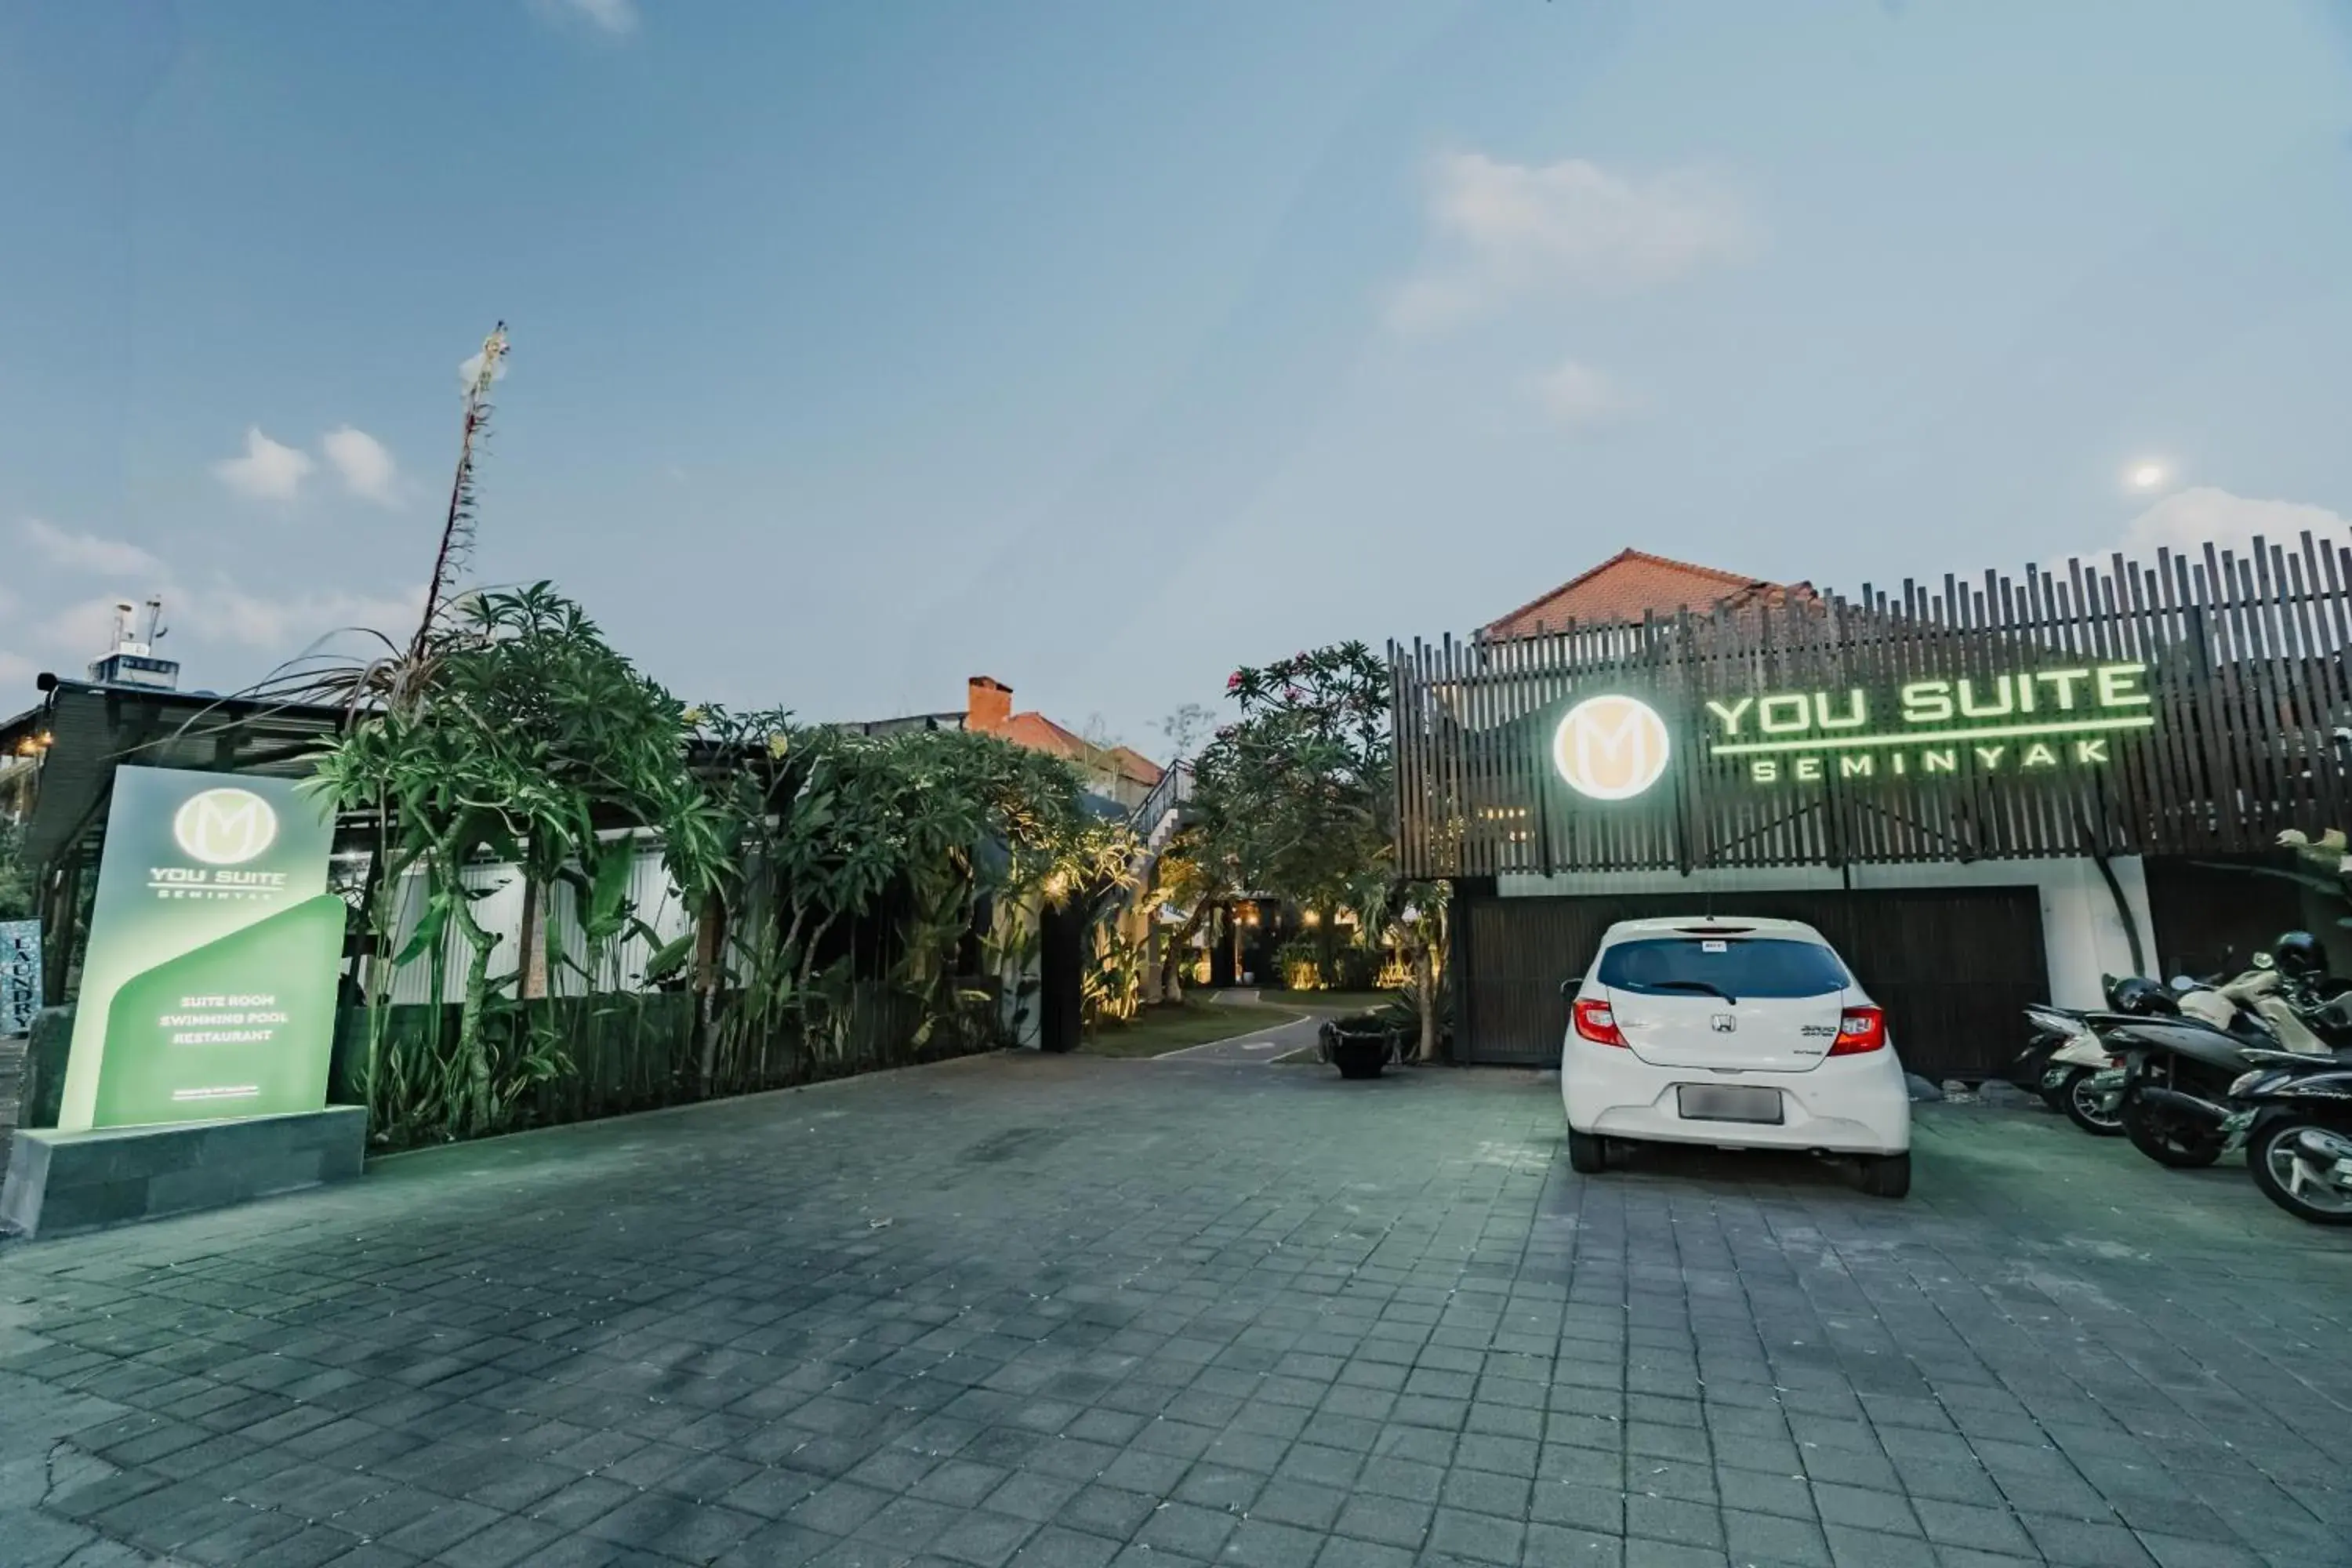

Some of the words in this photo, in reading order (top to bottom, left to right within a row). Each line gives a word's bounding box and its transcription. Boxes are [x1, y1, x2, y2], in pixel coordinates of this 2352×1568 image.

[1706, 688, 1866, 735] YOU
[1902, 663, 2151, 722] SUITE
[1752, 739, 2108, 782] SEMINYAK
[150, 867, 207, 882] YOU
[214, 870, 288, 885] SUITE
[158, 889, 274, 901] SEMINYAK
[13, 938, 33, 1027] LAUNDRY
[181, 996, 227, 1008] SUITE
[229, 994, 276, 1007] ROOM
[159, 1013, 244, 1027] SWIMMING
[247, 1011, 289, 1024] POOL
[172, 1029, 273, 1044] RESTAURANT
